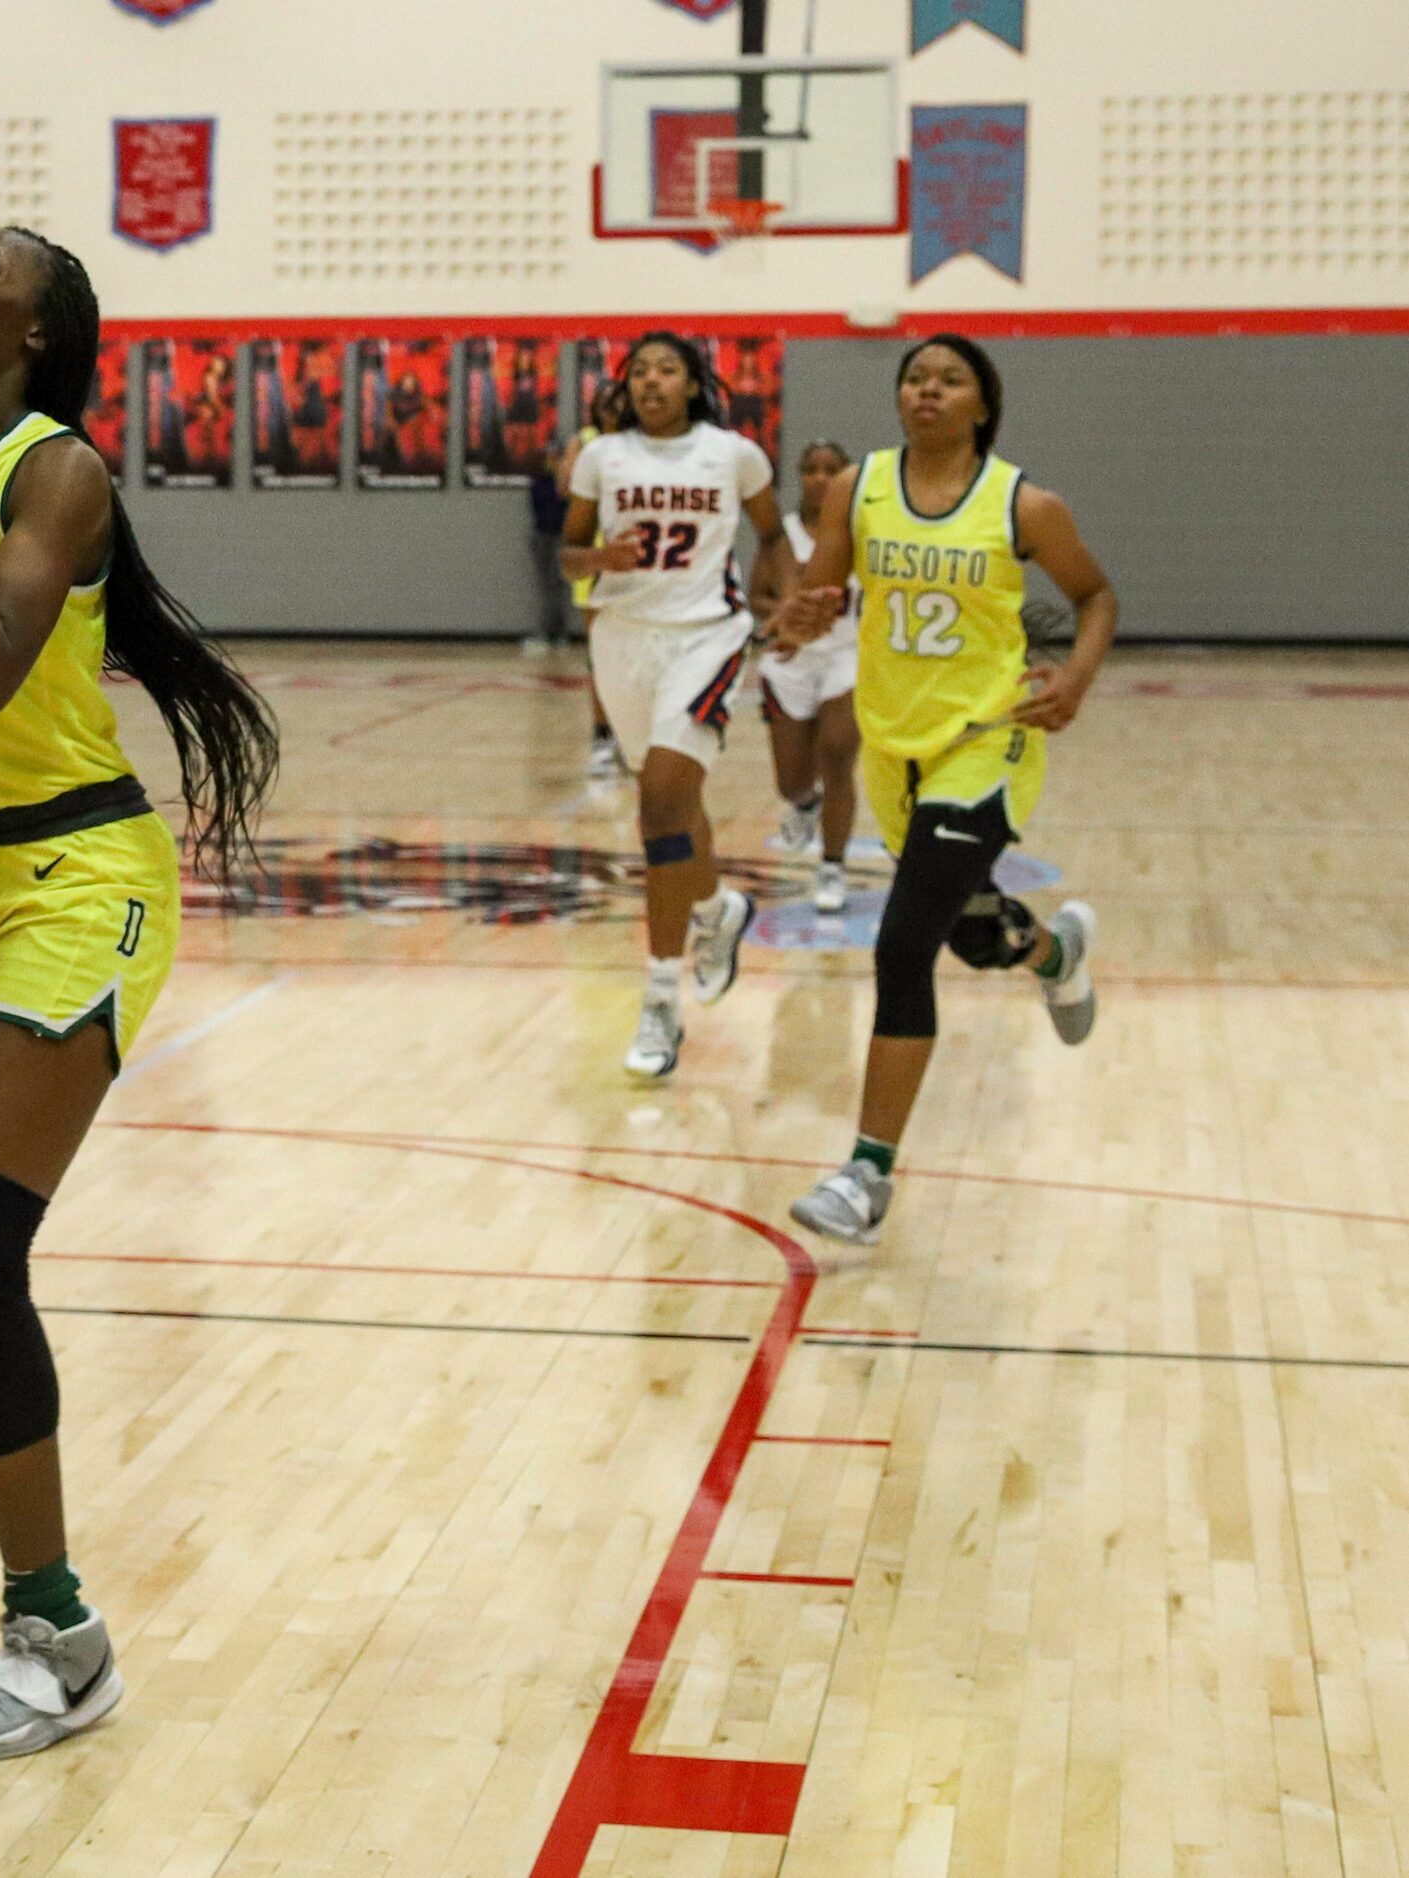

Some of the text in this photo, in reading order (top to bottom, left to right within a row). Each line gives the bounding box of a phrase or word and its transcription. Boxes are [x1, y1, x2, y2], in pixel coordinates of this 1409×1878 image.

[616, 485, 720, 514] SACHSE
[635, 519, 699, 572] 32
[867, 538, 987, 588] DESOTO
[885, 587, 965, 658] 12
[116, 897, 145, 958] D
